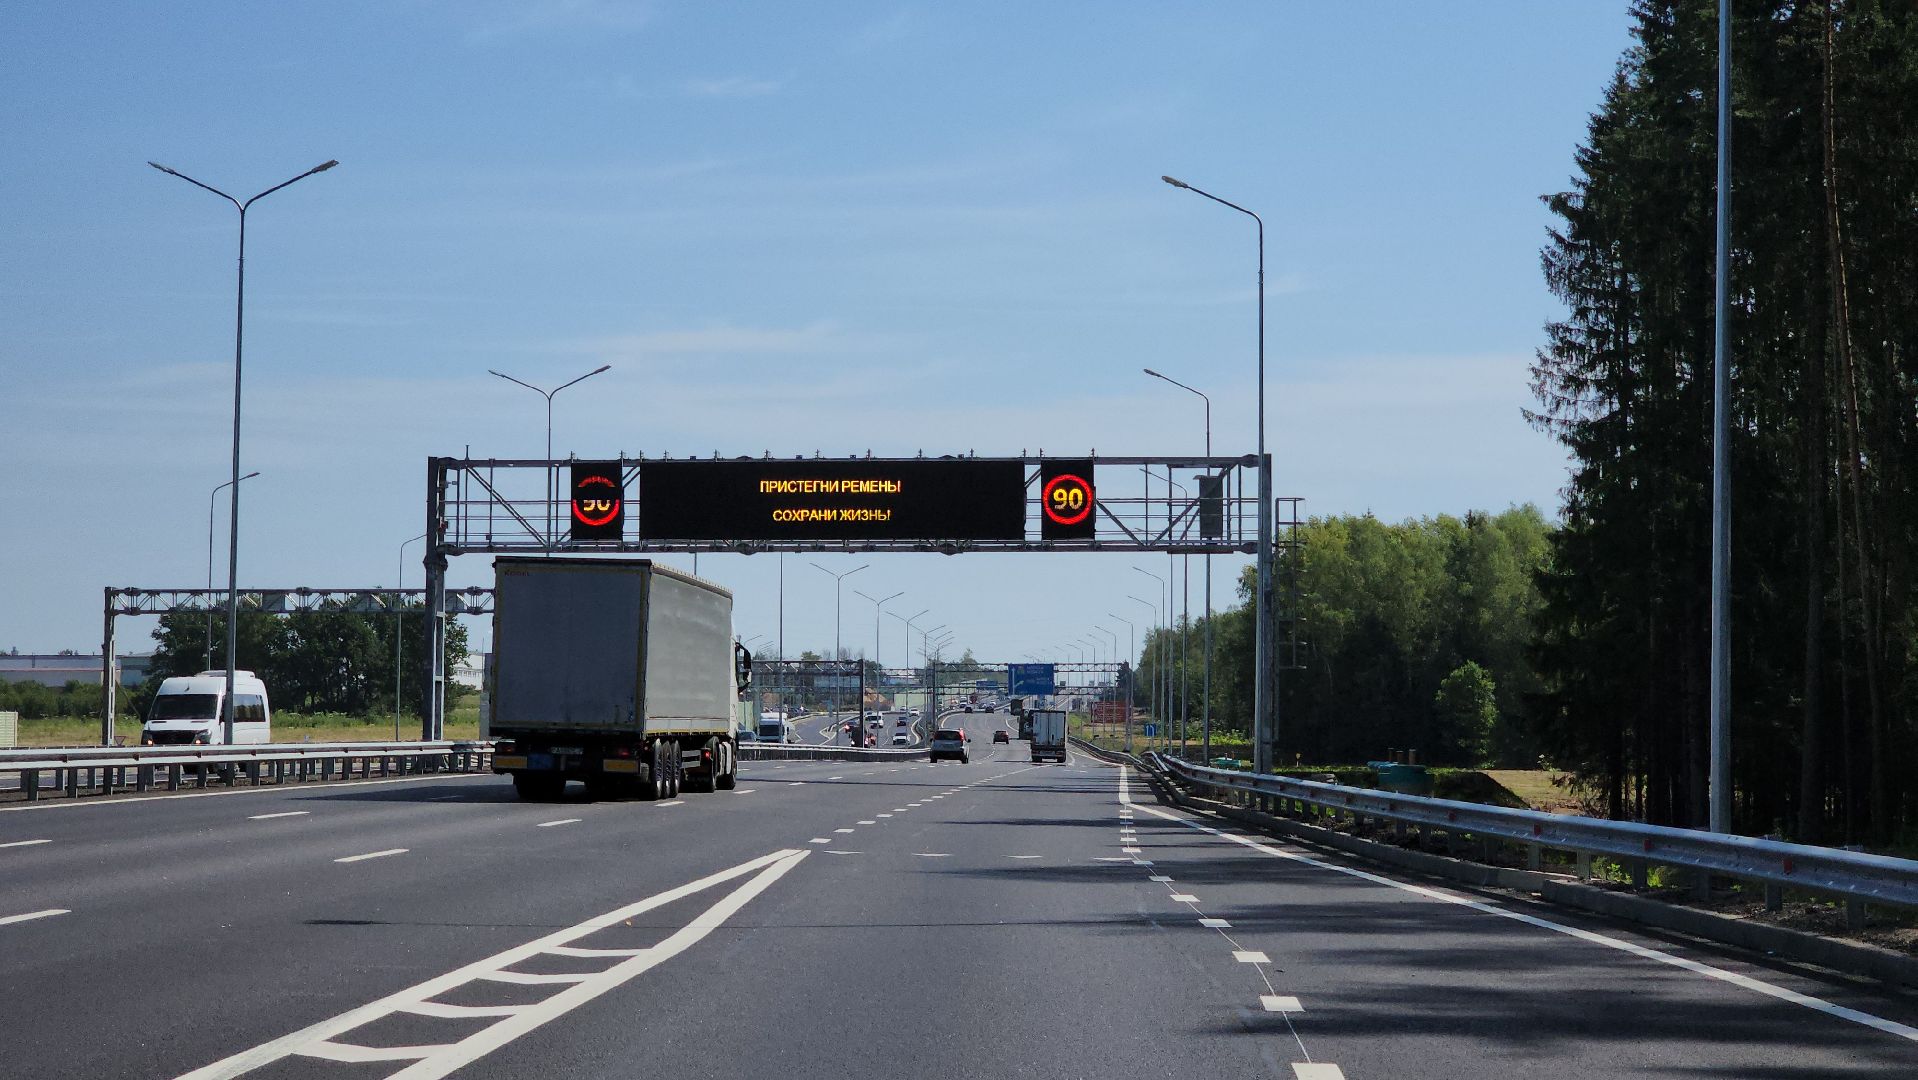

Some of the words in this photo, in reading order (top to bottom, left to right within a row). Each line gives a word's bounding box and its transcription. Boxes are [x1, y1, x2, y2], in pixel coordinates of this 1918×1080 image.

[760, 480, 839, 493] ПРИСТЕГНИ
[1053, 488, 1083, 510] 90
[772, 509, 837, 522] СОХРАНИ
